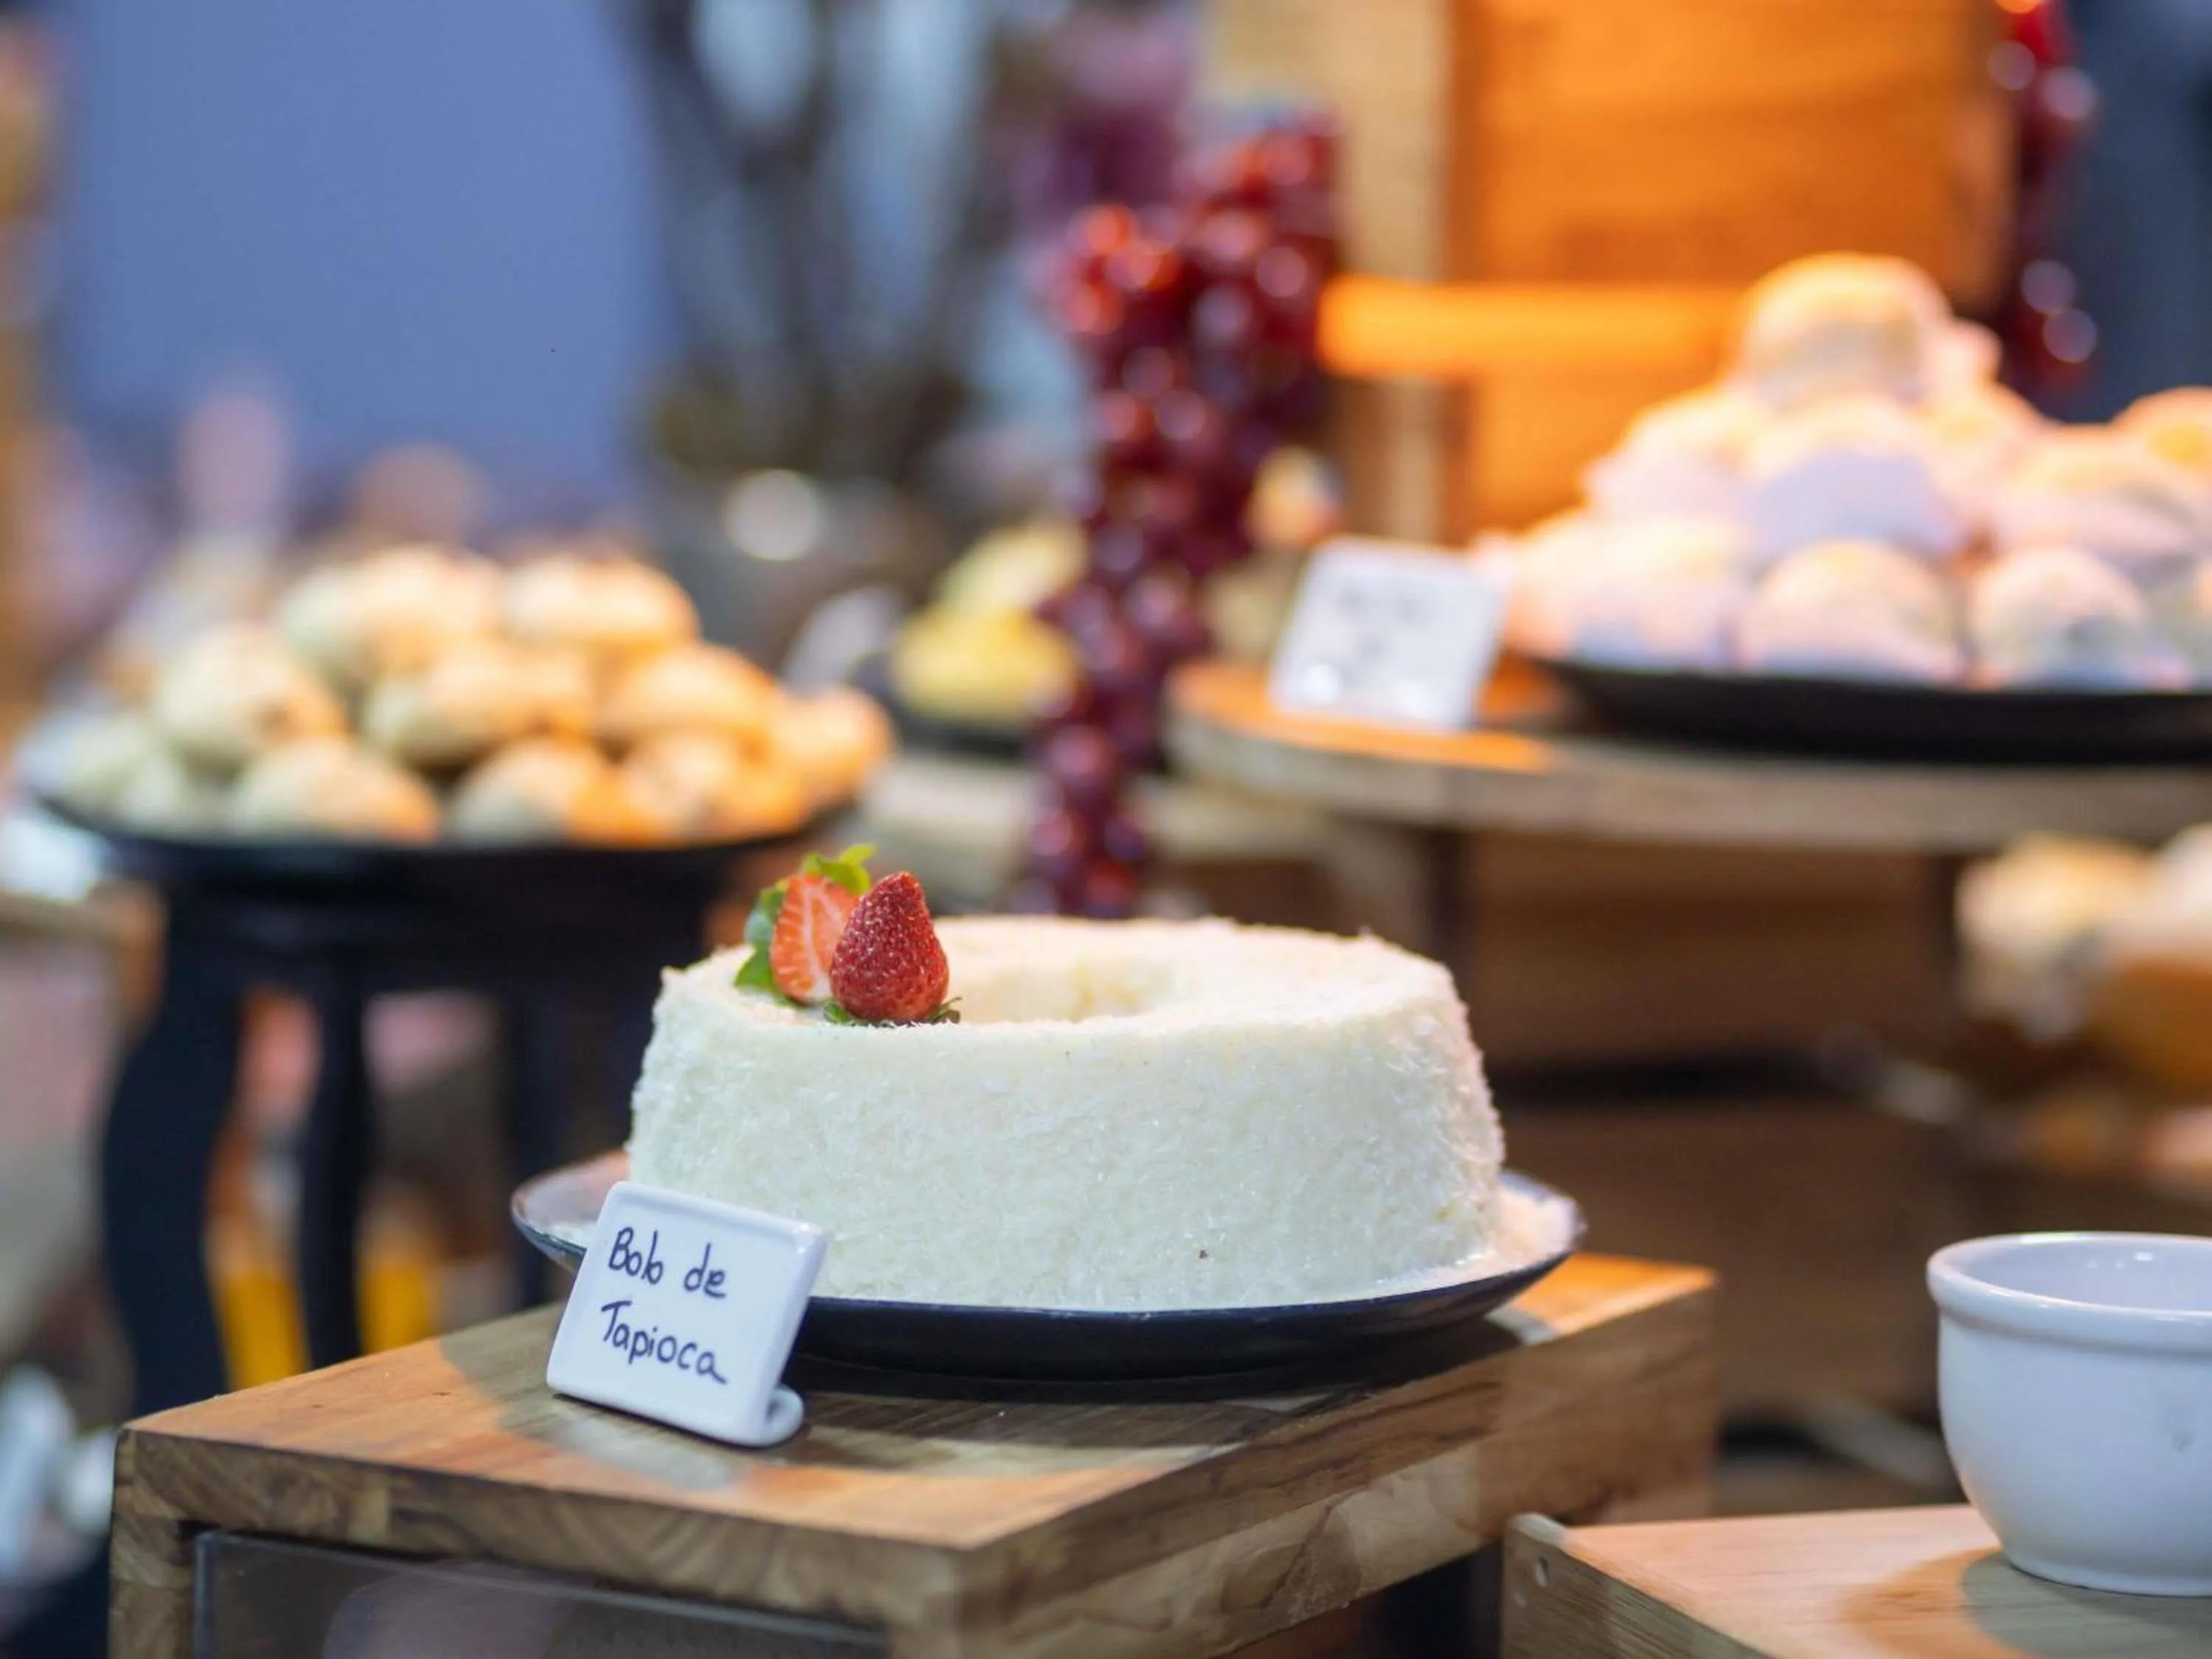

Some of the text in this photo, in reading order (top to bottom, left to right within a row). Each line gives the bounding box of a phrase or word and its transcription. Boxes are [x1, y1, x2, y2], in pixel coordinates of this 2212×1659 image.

[608, 1227, 727, 1298] Bolo de
[601, 1300, 727, 1385] Tapioca
